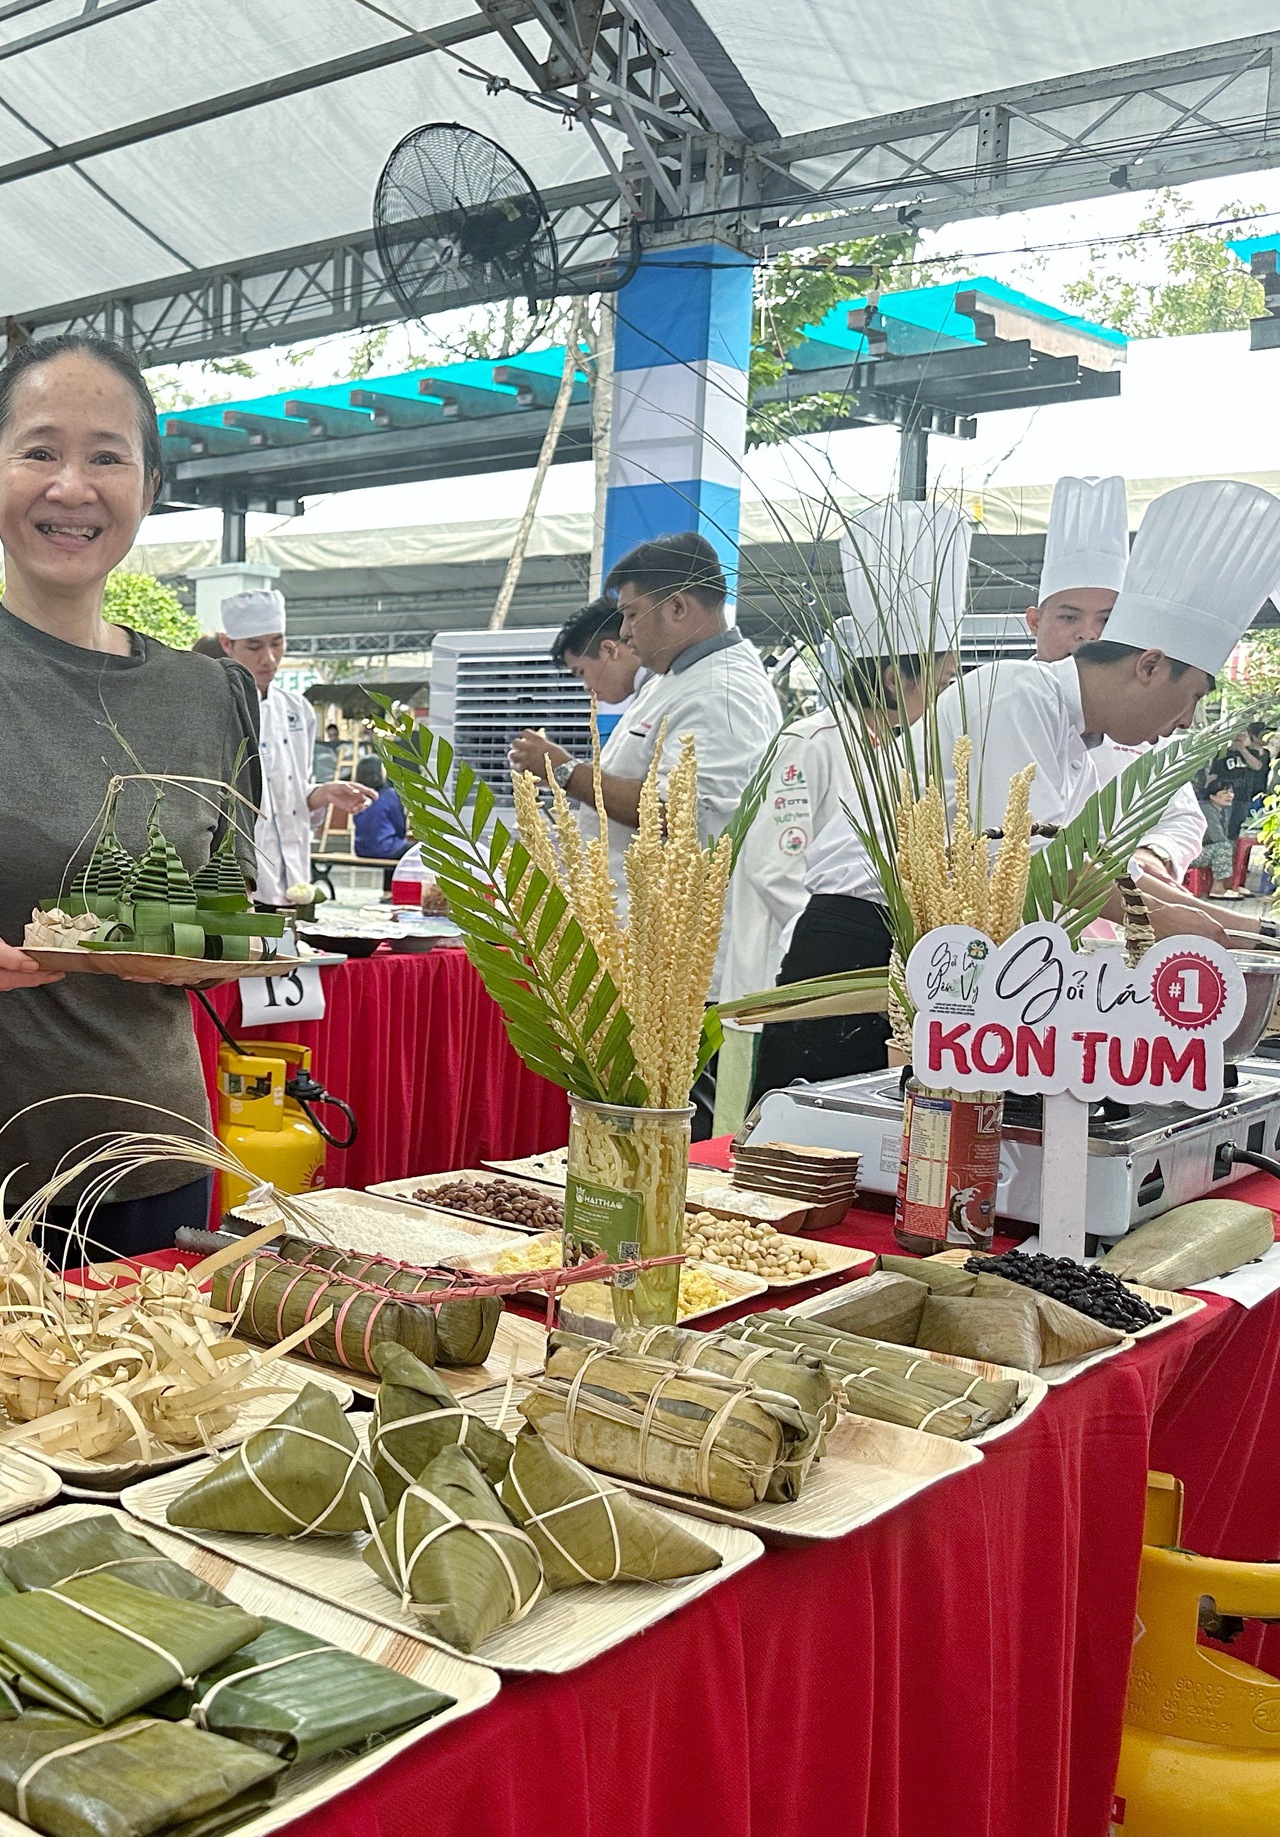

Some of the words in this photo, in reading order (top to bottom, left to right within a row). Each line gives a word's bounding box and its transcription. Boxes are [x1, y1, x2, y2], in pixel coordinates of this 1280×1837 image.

[995, 936, 1088, 1025] Gỏi
[928, 1021, 1056, 1077] KON
[1071, 1032, 1207, 1091] TUM
